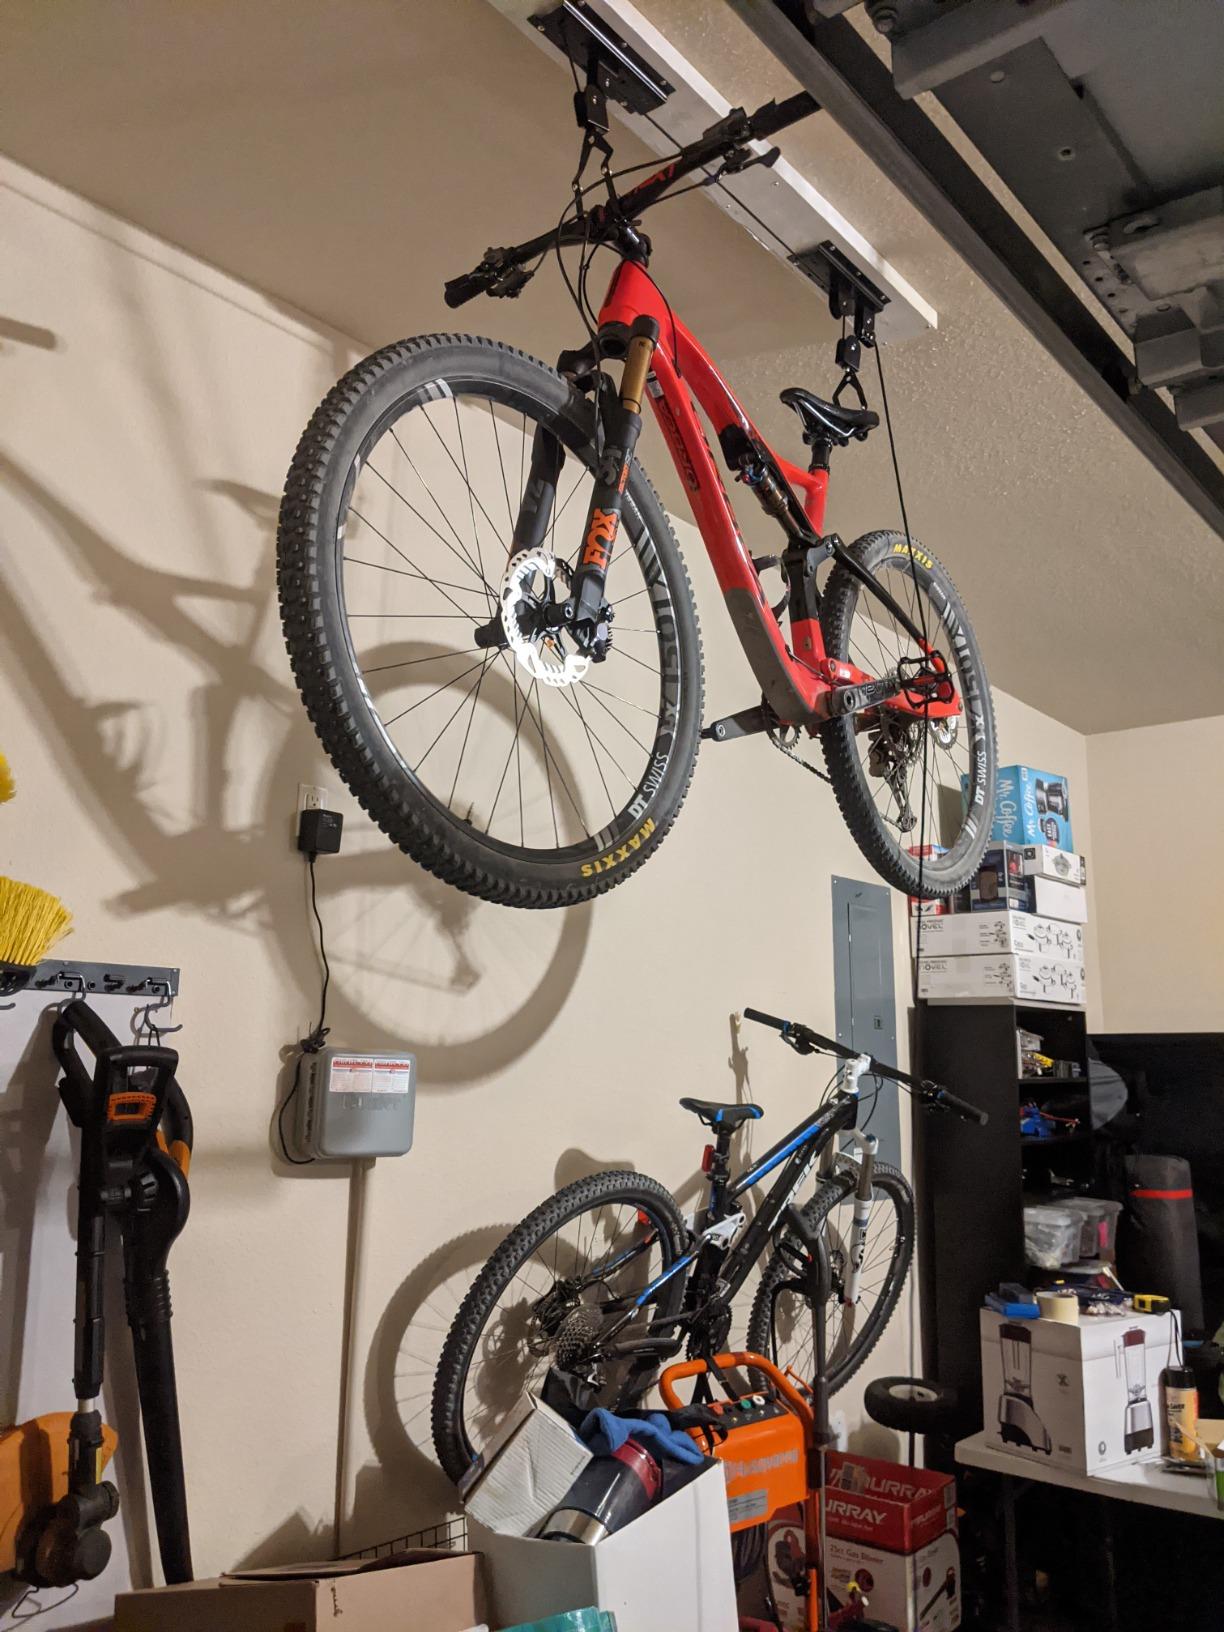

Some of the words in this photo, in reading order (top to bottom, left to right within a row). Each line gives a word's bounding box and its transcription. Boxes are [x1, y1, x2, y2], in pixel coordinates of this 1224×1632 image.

[583, 508, 619, 570] FOX
[627, 794, 649, 820] DT
[643, 751, 669, 798] SWISS
[976, 750, 988, 786] SWISS
[975, 787, 986, 806] DT
[995, 800, 1017, 839] Coffee
[580, 817, 657, 877] MAXXIS
[825, 1499, 888, 1526] URRAY
